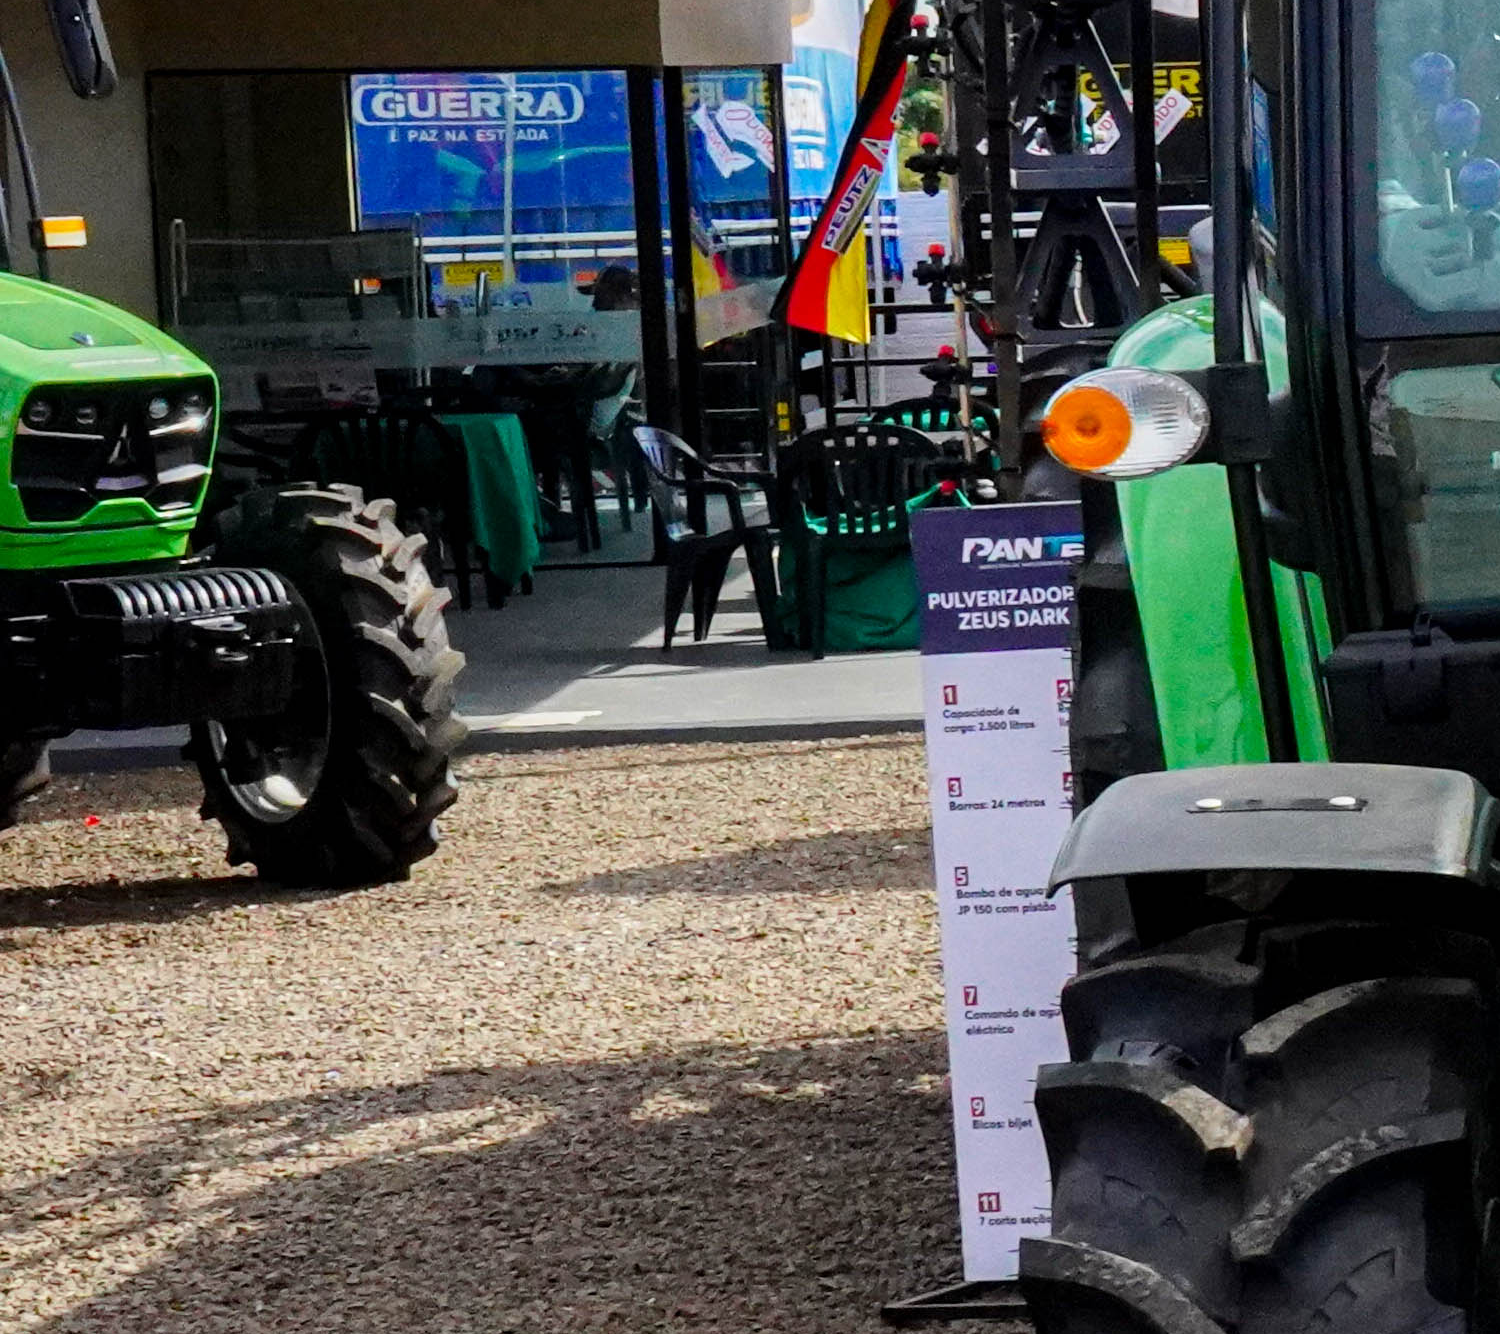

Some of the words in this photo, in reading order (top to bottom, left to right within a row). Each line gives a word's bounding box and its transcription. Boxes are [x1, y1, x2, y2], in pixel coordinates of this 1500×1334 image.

[371, 91, 567, 118] GUERRA
[408, 128, 438, 142] PAZ
[446, 128, 469, 142] NA
[476, 127, 550, 142] ESTADA
[958, 610, 1010, 631] ZEUS
[1014, 607, 1071, 628] DARK
[943, 707, 1004, 720] Capacidade
[1007, 798, 1046, 809] metros
[956, 889, 996, 900] Bomba
[995, 905, 1019, 914] com
[964, 1008, 1019, 1021] Comando
